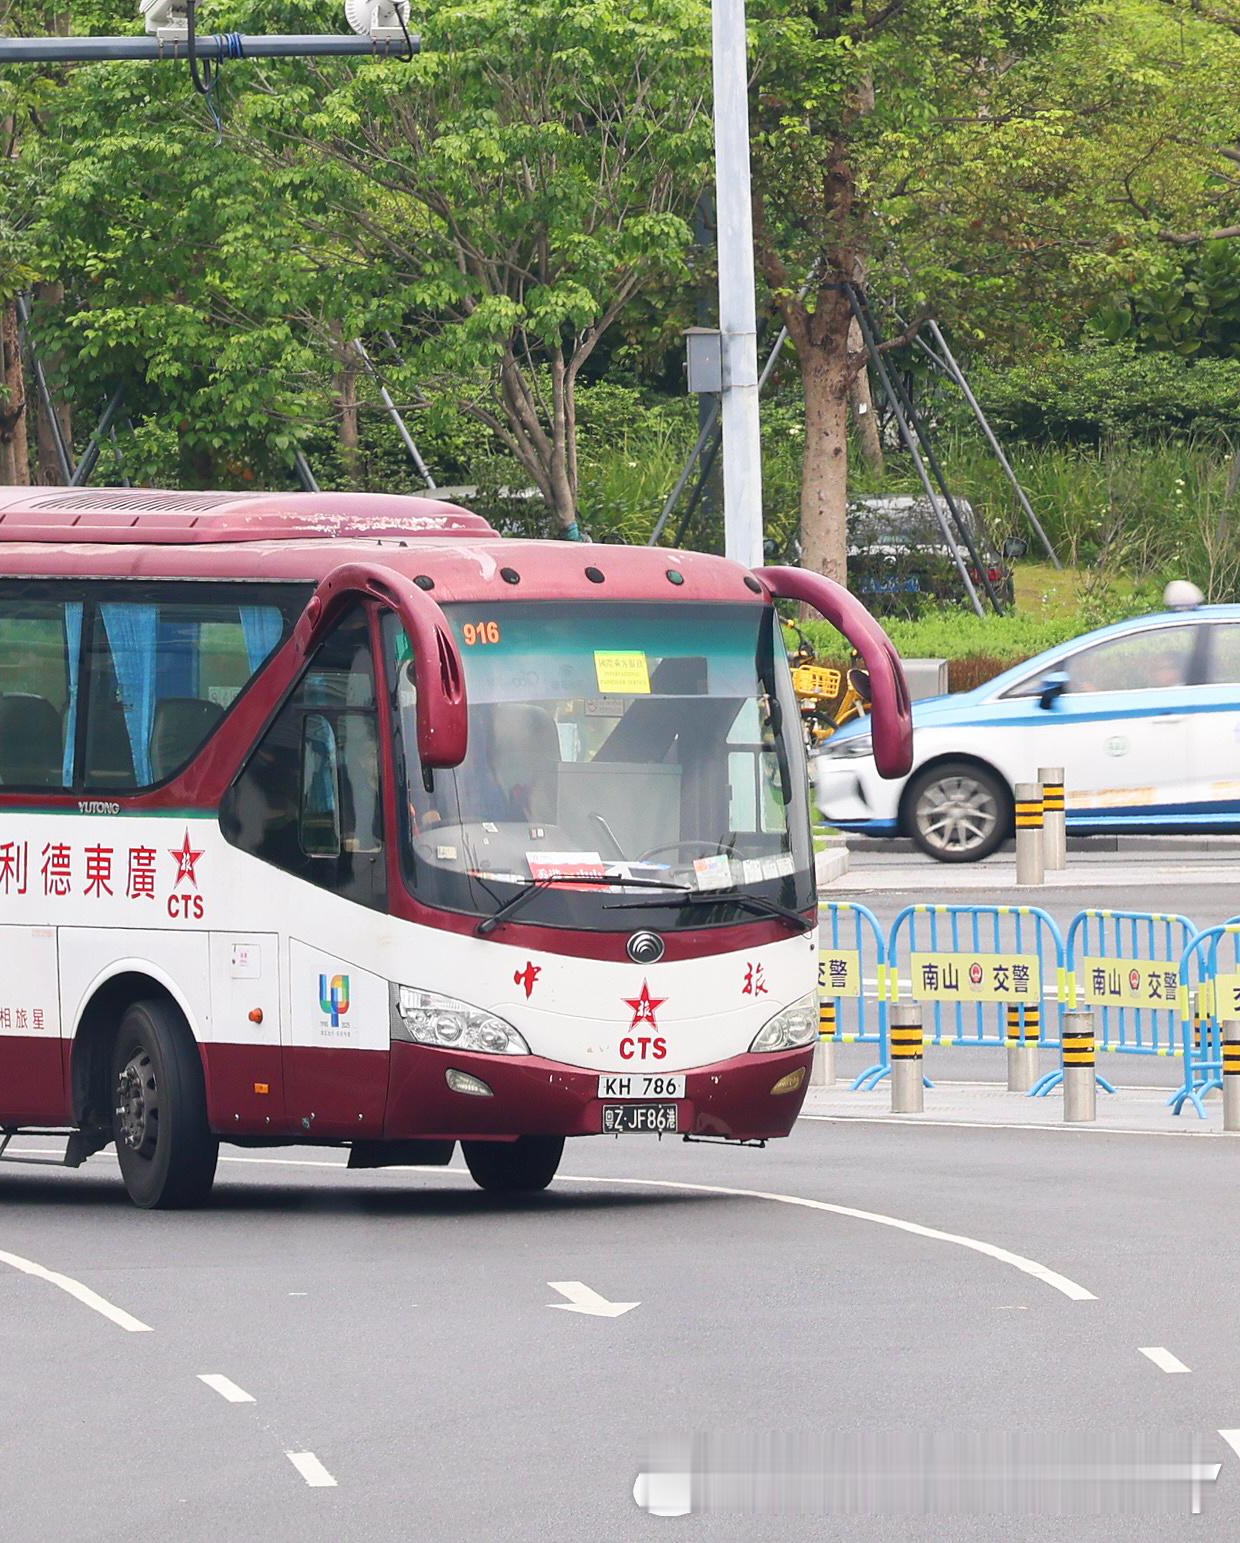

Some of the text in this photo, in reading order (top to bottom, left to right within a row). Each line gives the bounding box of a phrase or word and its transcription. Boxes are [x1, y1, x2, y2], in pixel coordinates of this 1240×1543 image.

[463, 621, 500, 645] 916
[78, 801, 120, 814] YUTONG
[167, 894, 204, 919] CTS
[922, 963, 1030, 993] 南山 交警
[1092, 967, 1178, 1001] 南山 交警
[619, 1037, 667, 1060] CTS
[606, 1077, 677, 1095] KH 786
